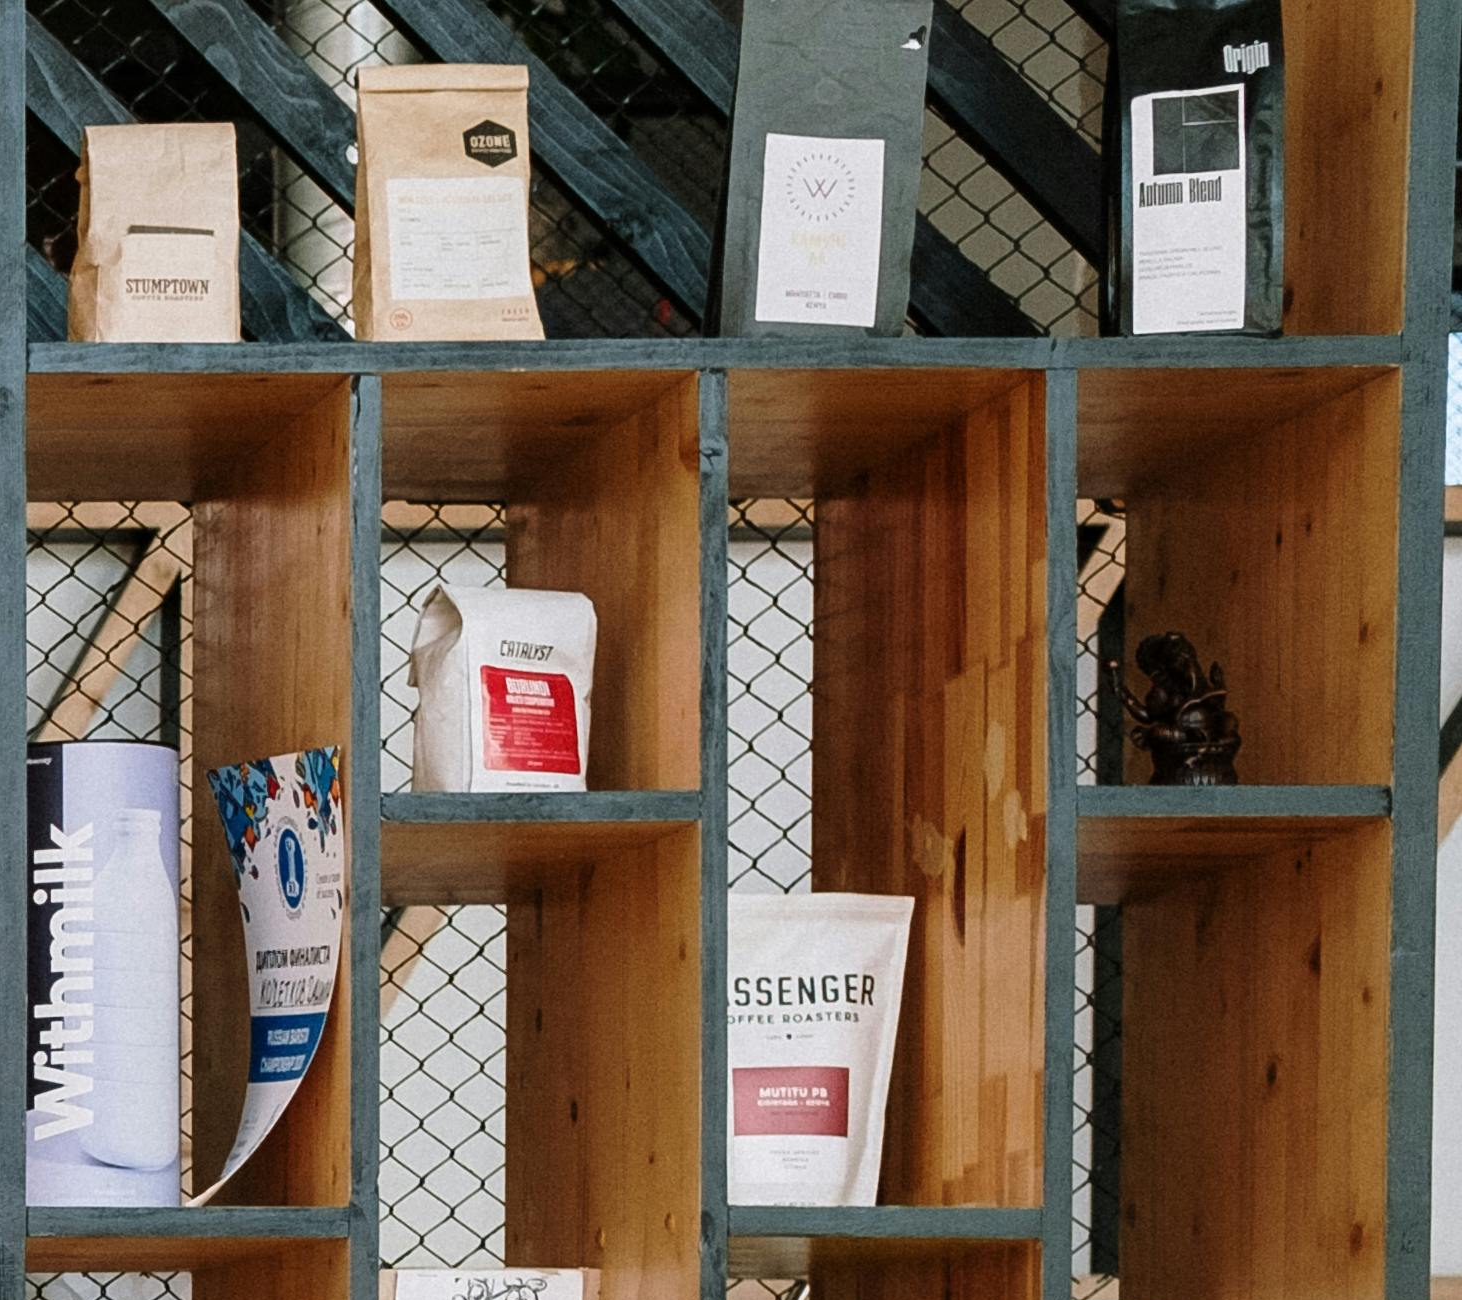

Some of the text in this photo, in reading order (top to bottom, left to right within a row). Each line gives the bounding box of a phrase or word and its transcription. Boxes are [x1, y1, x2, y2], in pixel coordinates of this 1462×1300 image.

[1223, 41, 1270, 74] Origin
[470, 134, 510, 148] OZONE
[1139, 176, 1221, 208] Autumn Blend
[126, 279, 209, 296] STUMPTOWN
[500, 640, 554, 661] CATALYST
[33, 823, 94, 1142] Withmilk
[783, 1012, 859, 1024] ROASTERS
[759, 1087, 807, 1097] MUTITU
